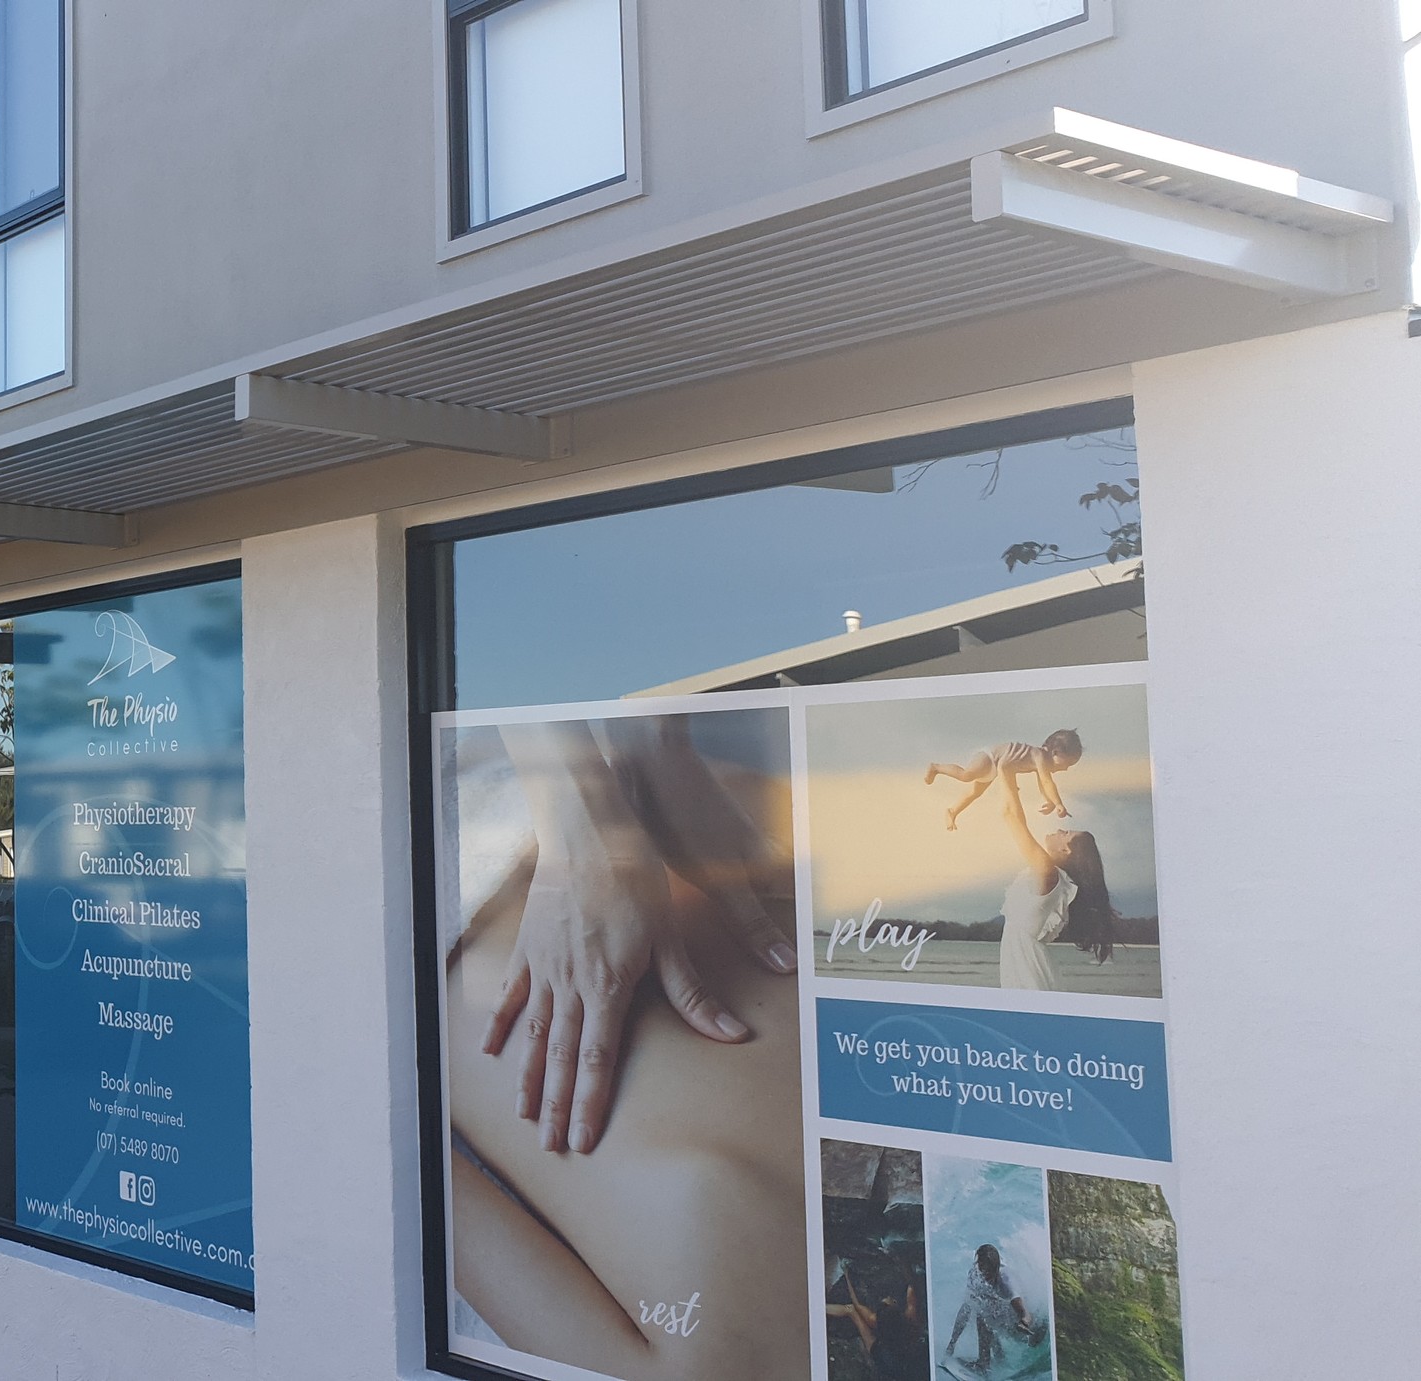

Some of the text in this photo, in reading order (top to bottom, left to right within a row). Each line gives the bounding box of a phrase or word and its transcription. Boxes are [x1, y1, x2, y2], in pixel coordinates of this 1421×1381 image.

[87, 692, 178, 737] The Physio
[87, 738, 179, 758] Collective
[72, 801, 197, 832] Physiotherapy
[78, 850, 192, 878] CranioSacral
[71, 898, 201, 930] Clinical Pilates
[824, 897, 937, 972] play
[80, 948, 192, 982] Acupuncture
[98, 1001, 174, 1040] Massage
[833, 1031, 1145, 1090] We get you back to doing
[101, 1070, 173, 1100] Book online
[891, 1071, 1074, 1112] what you love!
[89, 1097, 186, 1129] No referral required.
[96, 1130, 180, 1165] (07) 5489 8070
[638, 1291, 702, 1338] rest
